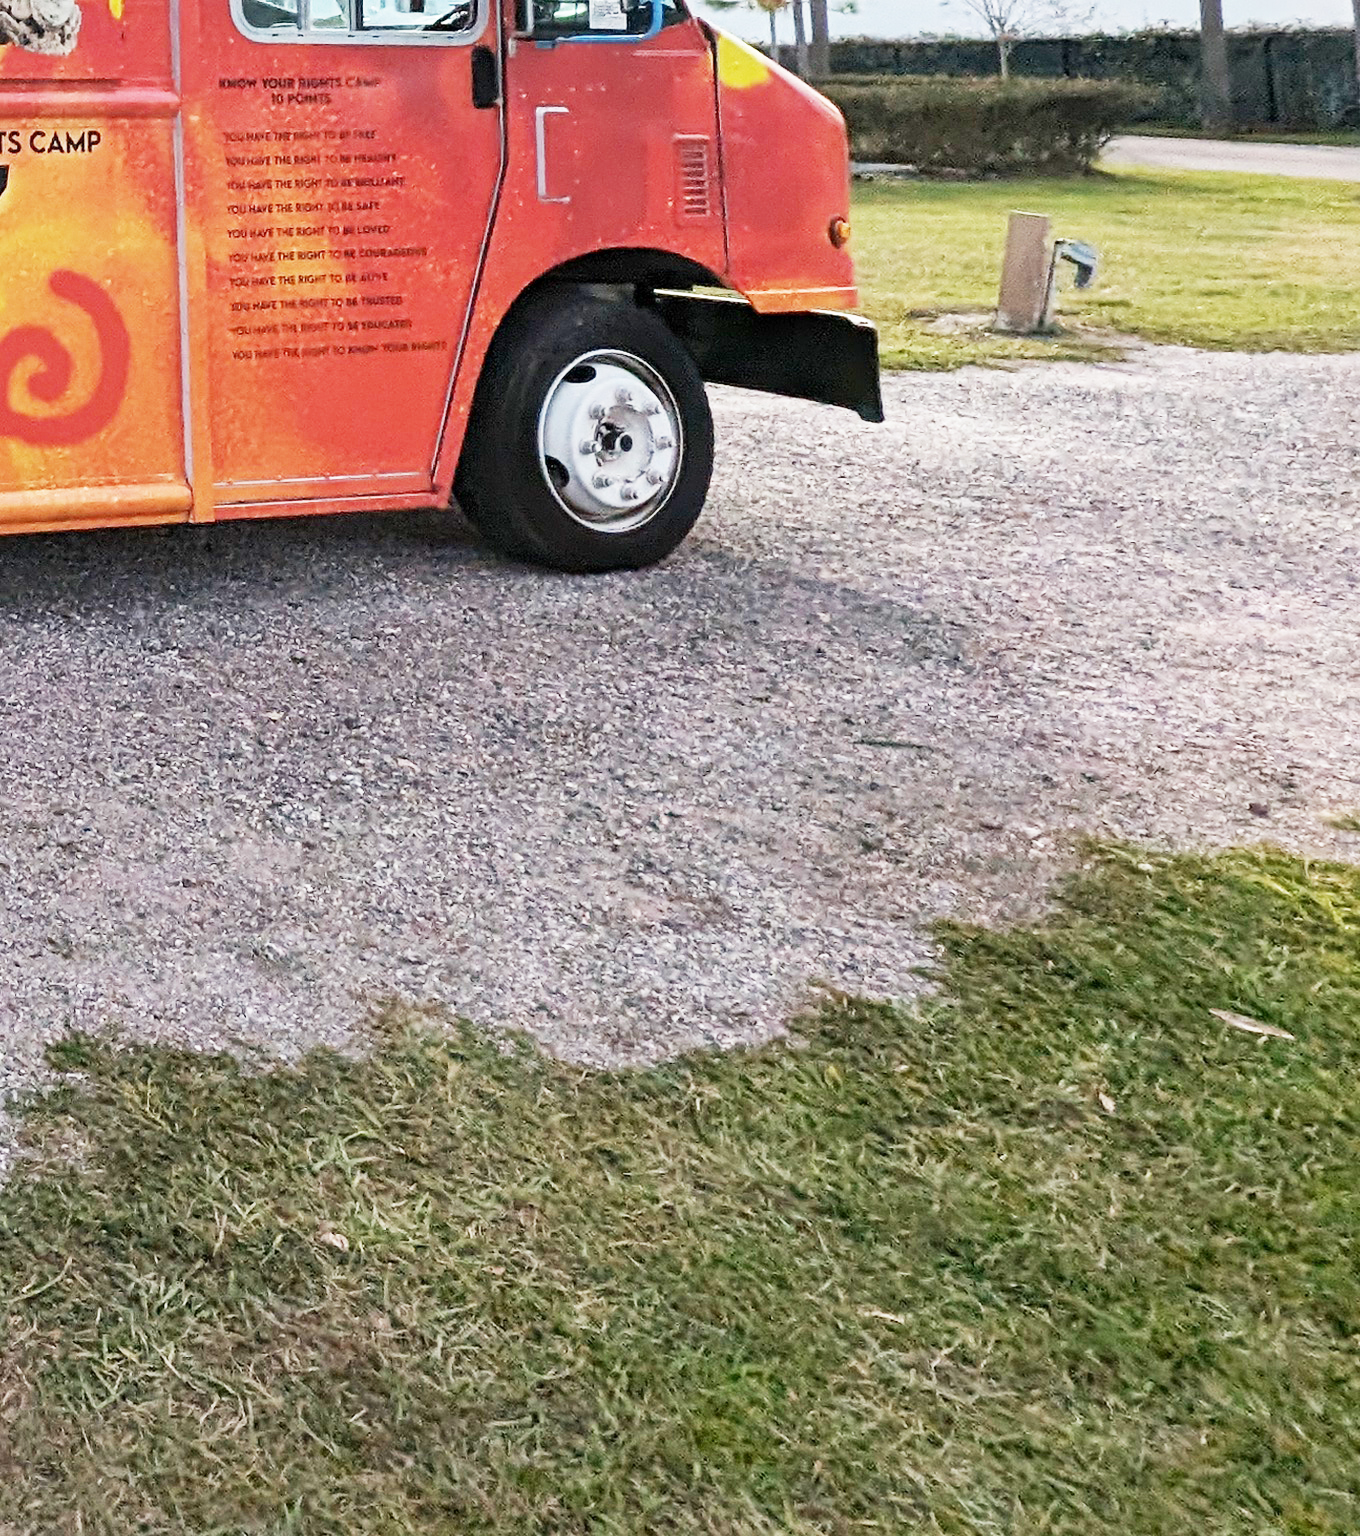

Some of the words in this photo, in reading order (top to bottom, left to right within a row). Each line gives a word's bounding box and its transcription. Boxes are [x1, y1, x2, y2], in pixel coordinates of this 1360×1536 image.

[262, 78, 295, 89] YOUR
[298, 78, 341, 89] RIGHTS
[30, 130, 102, 154] CAMP
